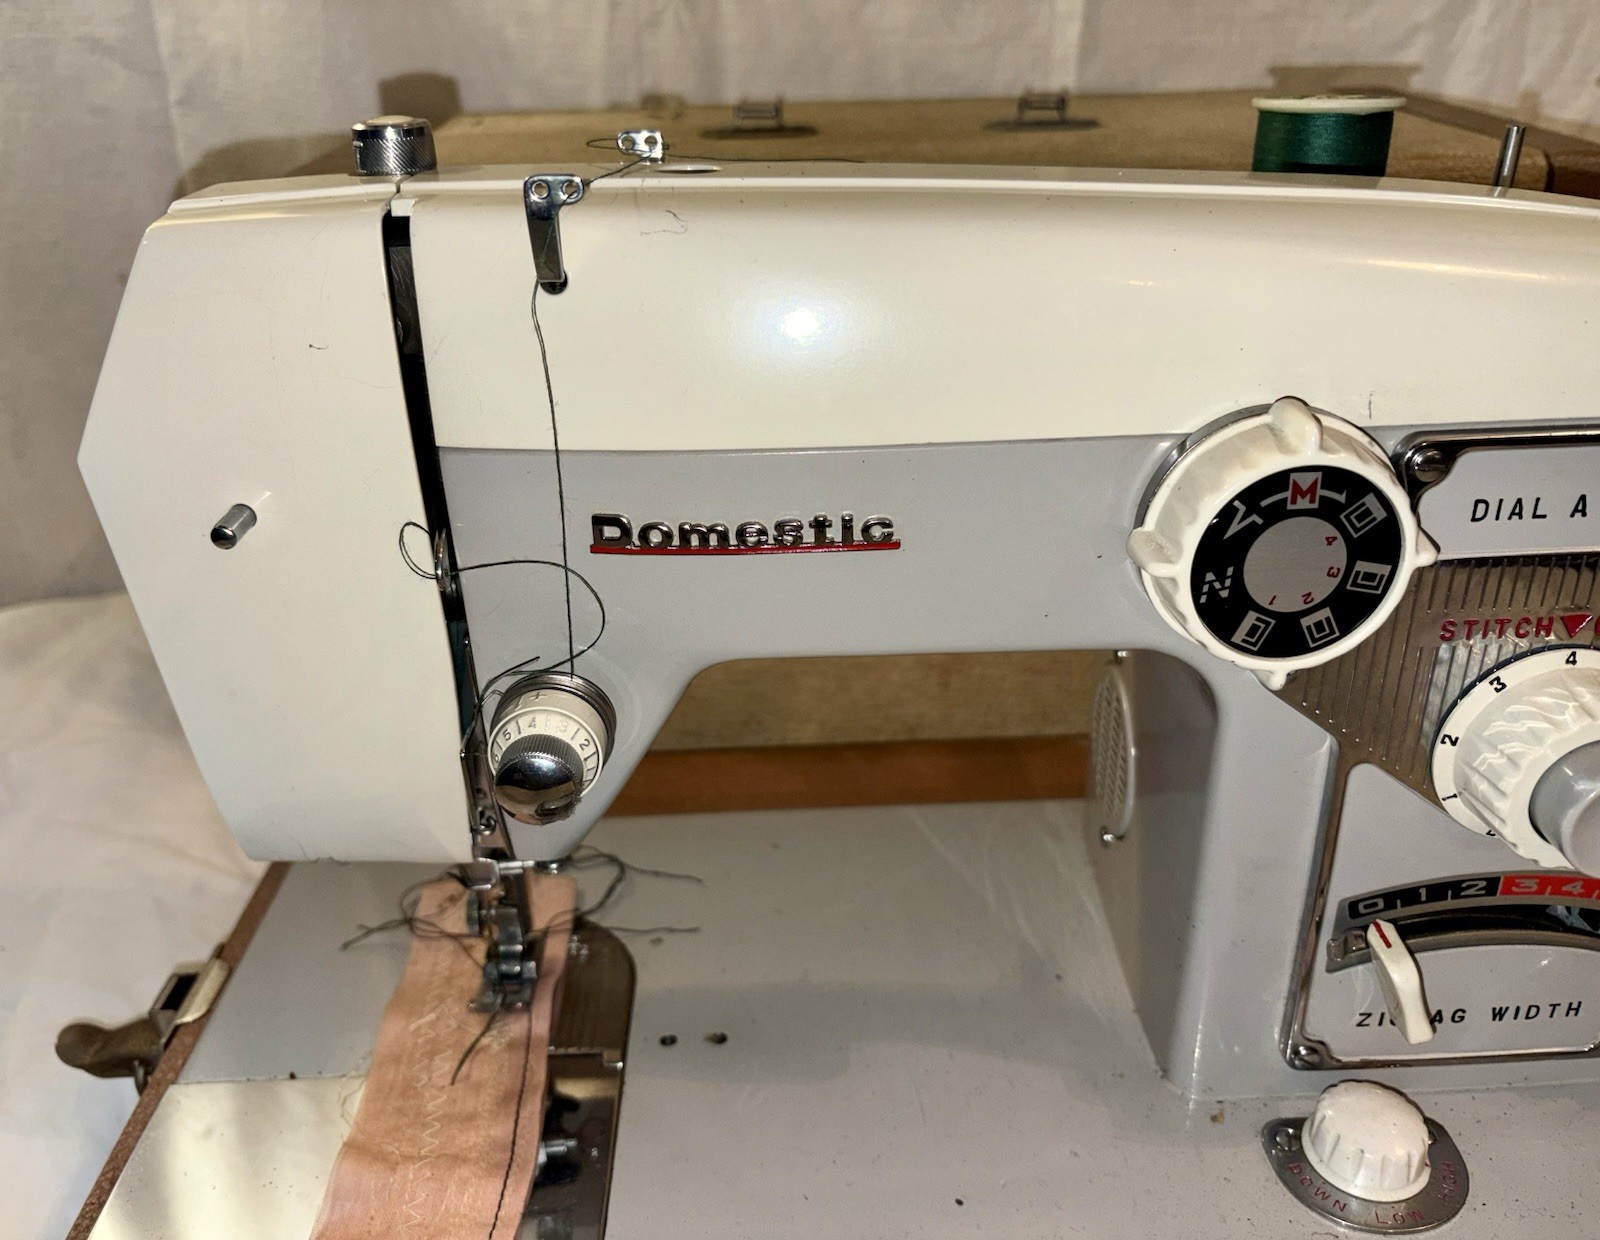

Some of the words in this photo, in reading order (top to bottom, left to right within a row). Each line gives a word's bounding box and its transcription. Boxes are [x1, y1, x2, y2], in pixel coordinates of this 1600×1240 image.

[1290, 478, 1319, 505] M
[1470, 497, 1547, 522] DIAL
[1570, 494, 1588, 518] A
[591, 512, 895, 548] Domestic
[1439, 615, 1555, 641] STITCH
[1565, 651, 1578, 666] 4
[1488, 676, 1507, 693] 3
[503, 729, 512, 741] 5
[579, 738, 590, 751] 2
[1440, 734, 1460, 747] 2
[1418, 888, 1427, 902] 1
[1460, 880, 1487, 896] 2
[1511, 878, 1540, 893] 3
[1561, 880, 1585, 895] 4
[1355, 1008, 1467, 1028] ZIAG
[1491, 1001, 1583, 1022] WIDTH
[1289, 1162, 1348, 1213] DOWN
[1375, 1209, 1425, 1225] LOW
